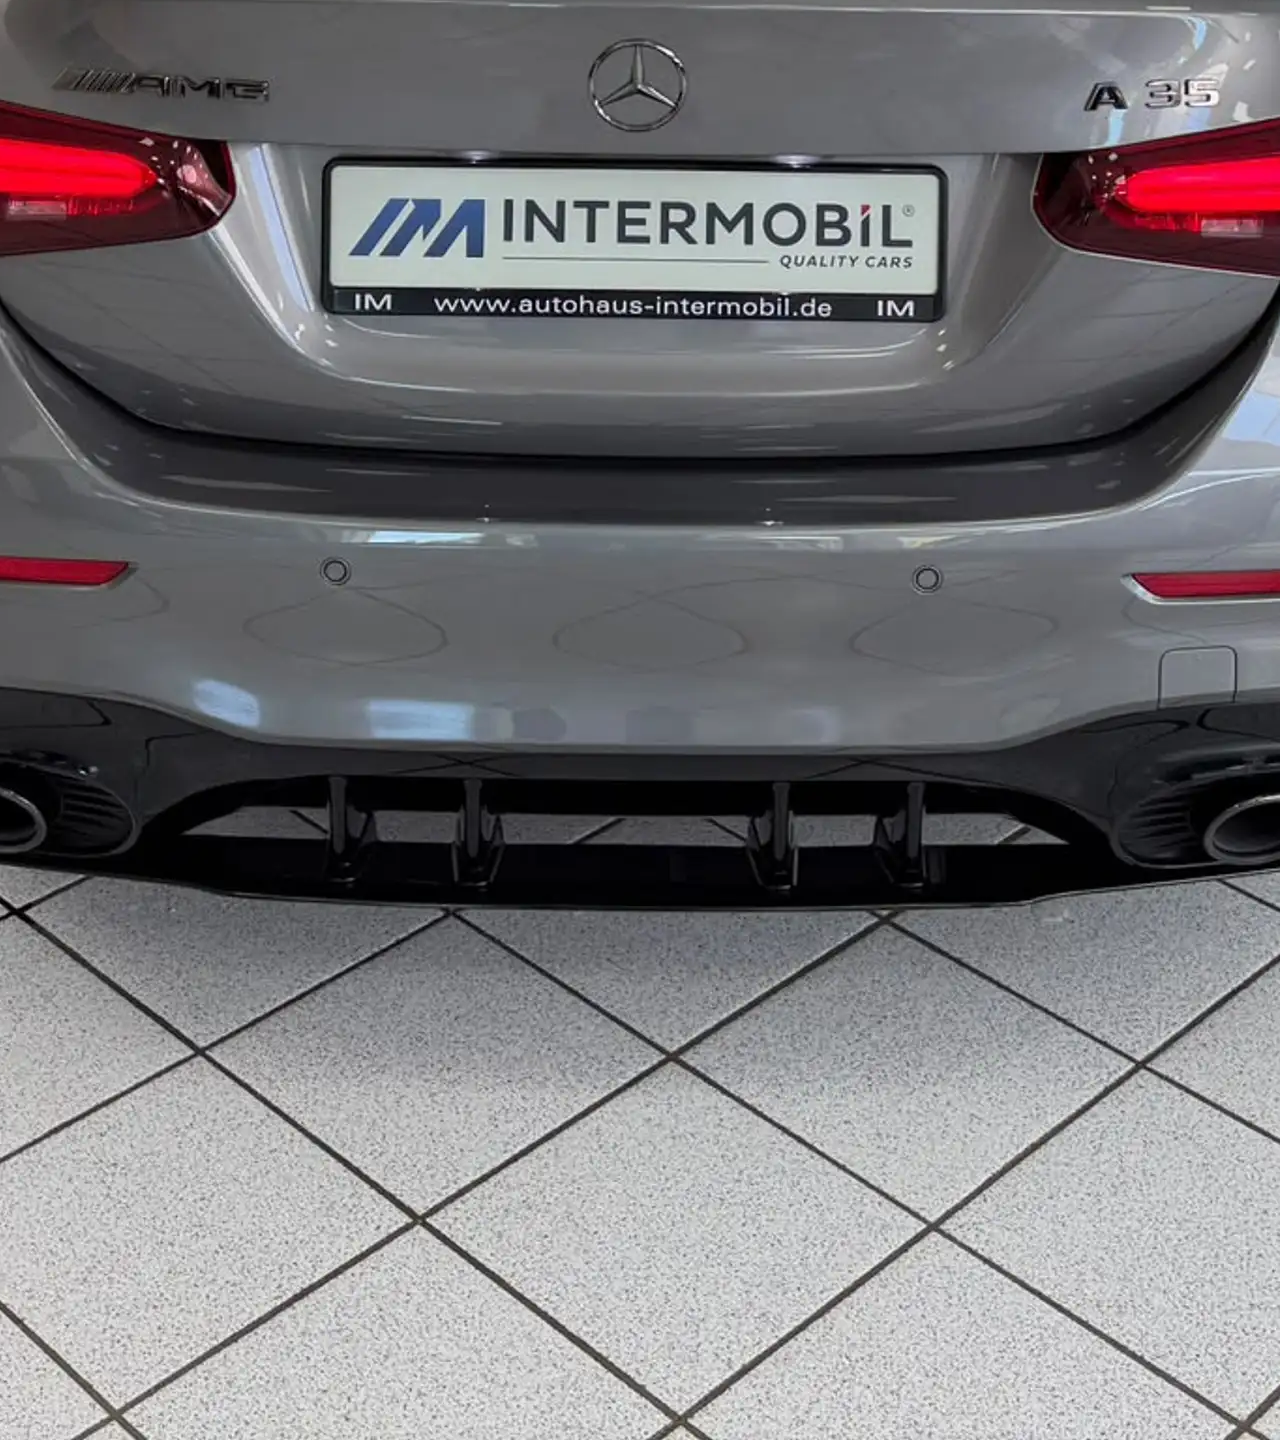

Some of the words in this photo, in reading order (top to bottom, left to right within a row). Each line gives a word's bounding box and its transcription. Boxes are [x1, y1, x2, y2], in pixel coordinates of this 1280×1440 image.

[128, 72, 269, 102] AMG
[1083, 80, 1129, 111] A
[1144, 78, 1220, 109] 35
[779, 254, 860, 270] QUALITY
[864, 255, 914, 269] CARS
[354, 293, 393, 311] IM
[433, 294, 833, 318] www.autohaus-intermobil.de
[876, 299, 916, 318] IM
